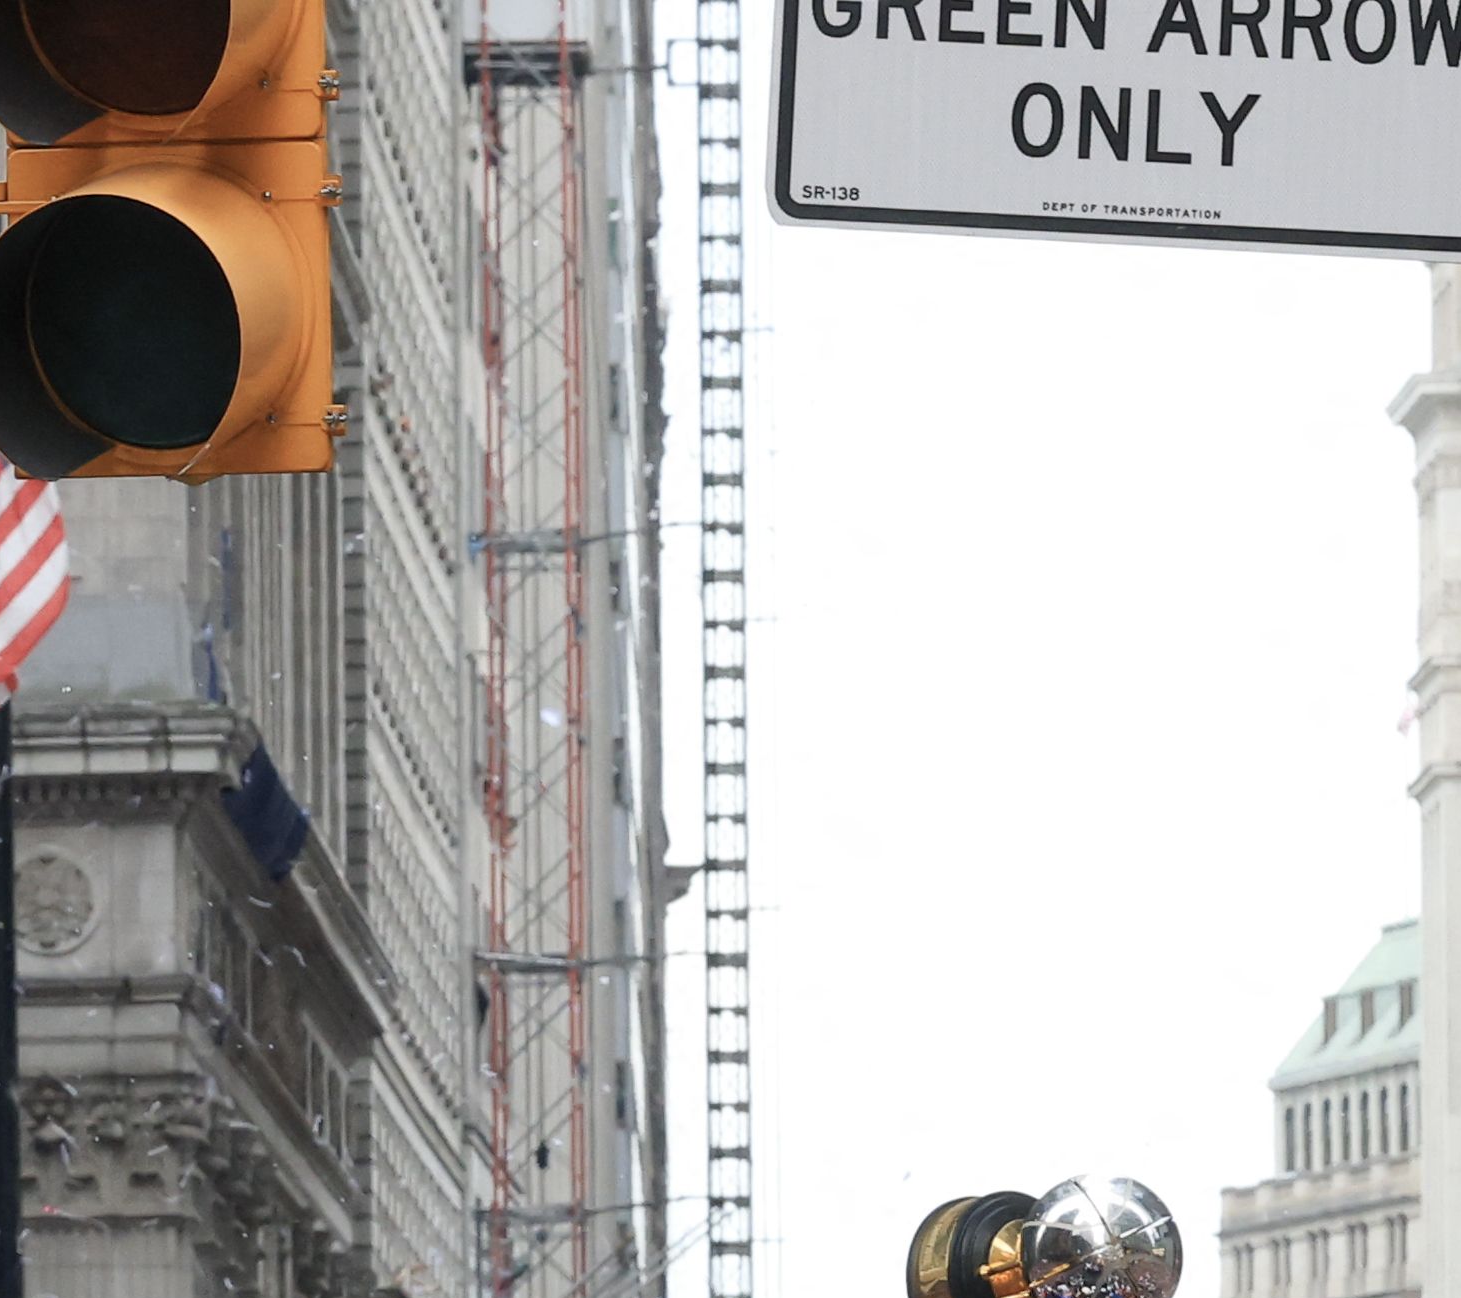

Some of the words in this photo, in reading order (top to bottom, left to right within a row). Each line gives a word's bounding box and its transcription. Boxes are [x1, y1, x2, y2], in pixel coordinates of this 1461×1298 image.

[1010, 83, 1262, 167] ONLY
[802, 185, 861, 201] SR-138
[1042, 201, 1075, 213] DEPT
[1081, 203, 1098, 213] OF
[1104, 204, 1222, 220] TRANSPORTATION
